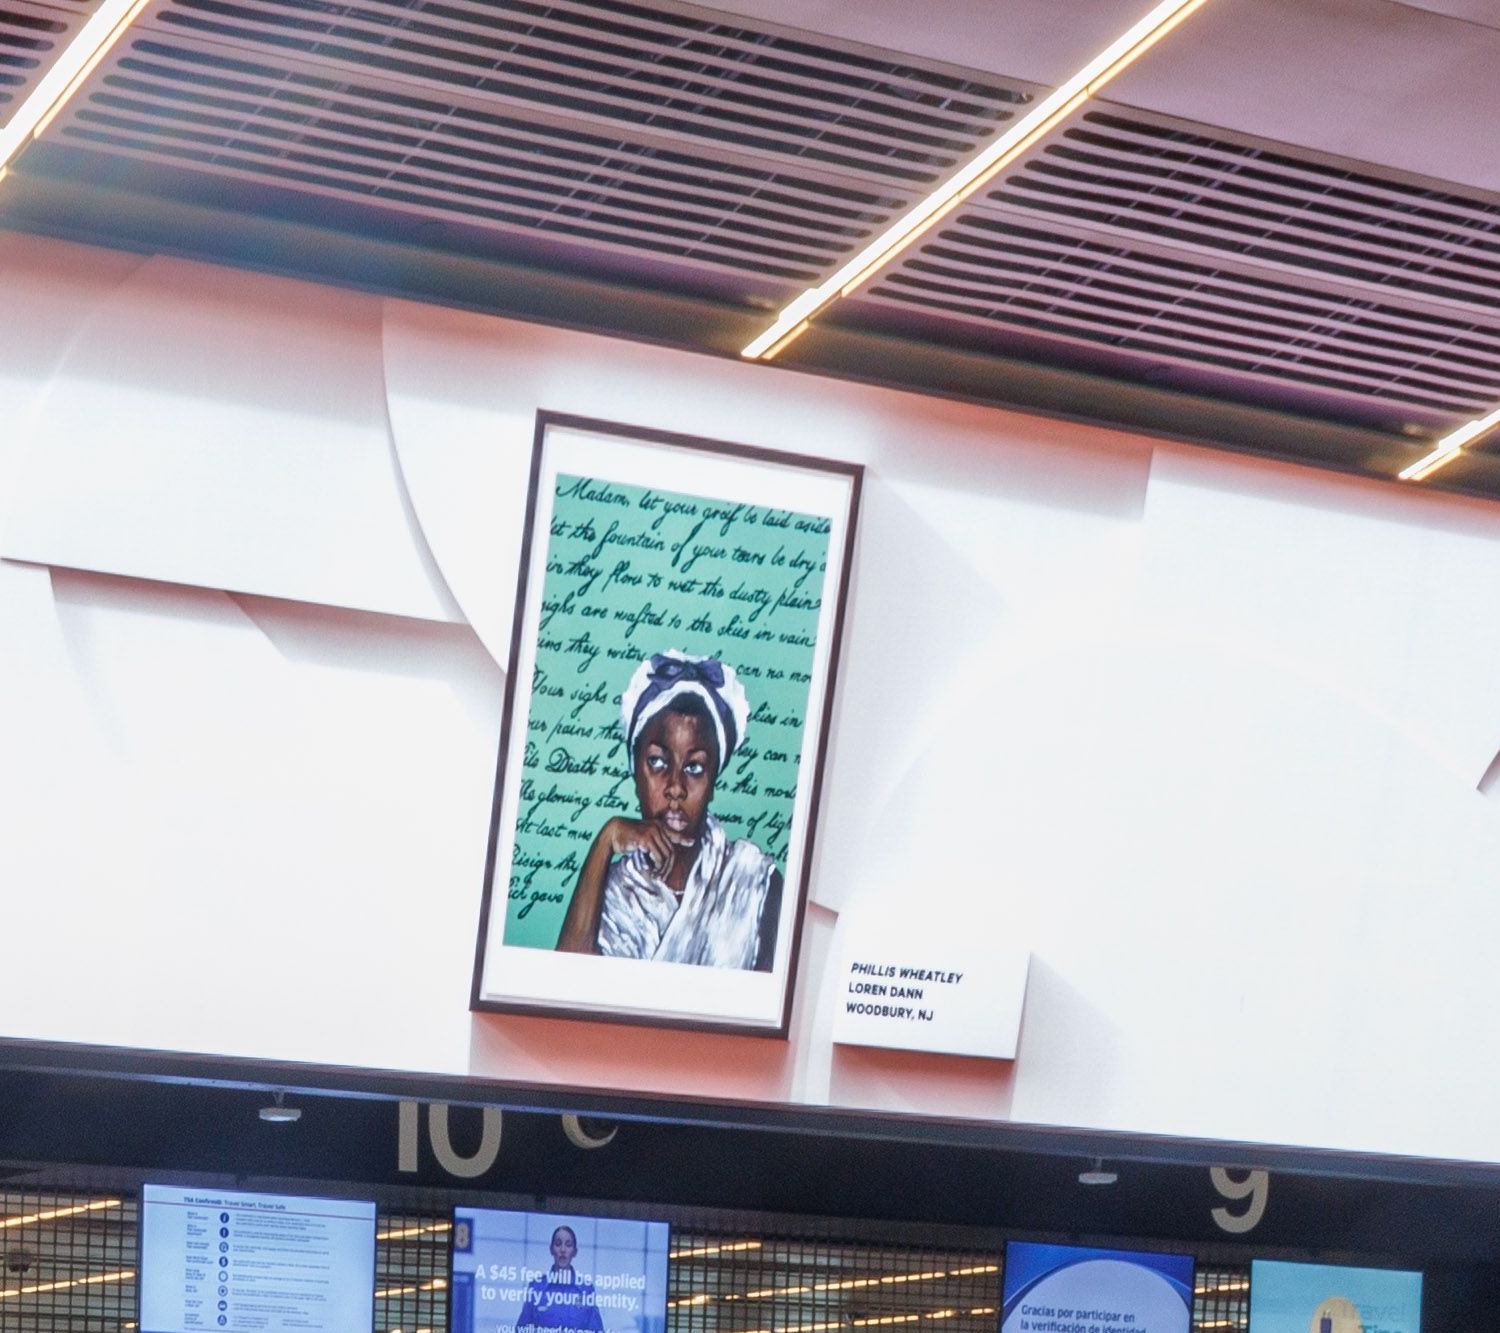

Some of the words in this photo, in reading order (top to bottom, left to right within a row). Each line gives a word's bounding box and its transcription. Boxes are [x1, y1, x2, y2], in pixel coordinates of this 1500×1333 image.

[639, 490, 664, 511] let
[651, 502, 697, 530] your
[762, 509, 790, 528] laid
[592, 520, 665, 559] fountain
[671, 525, 700, 567] of
[685, 543, 728, 572] your
[850, 962, 896, 978] PHILLIS
[899, 967, 964, 985] WHEATLEY
[849, 982, 887, 996] LOREN
[890, 986, 924, 1000] DANN
[846, 1002, 915, 1020] WOODBURY,
[918, 1009, 934, 1021] NJ
[398, 1100, 502, 1178] 10
[1210, 1165, 1269, 1234] 9
[474, 1264, 486, 1280] A
[489, 1265, 517, 1281] $45
[520, 1266, 542, 1283] fee
[546, 1269, 572, 1285] will
[575, 1269, 592, 1286] be
[595, 1273, 646, 1290] applied
[481, 1285, 496, 1300] to
[498, 1286, 543, 1306] verify
[546, 1291, 579, 1307] your
[582, 1291, 640, 1314] identity.
